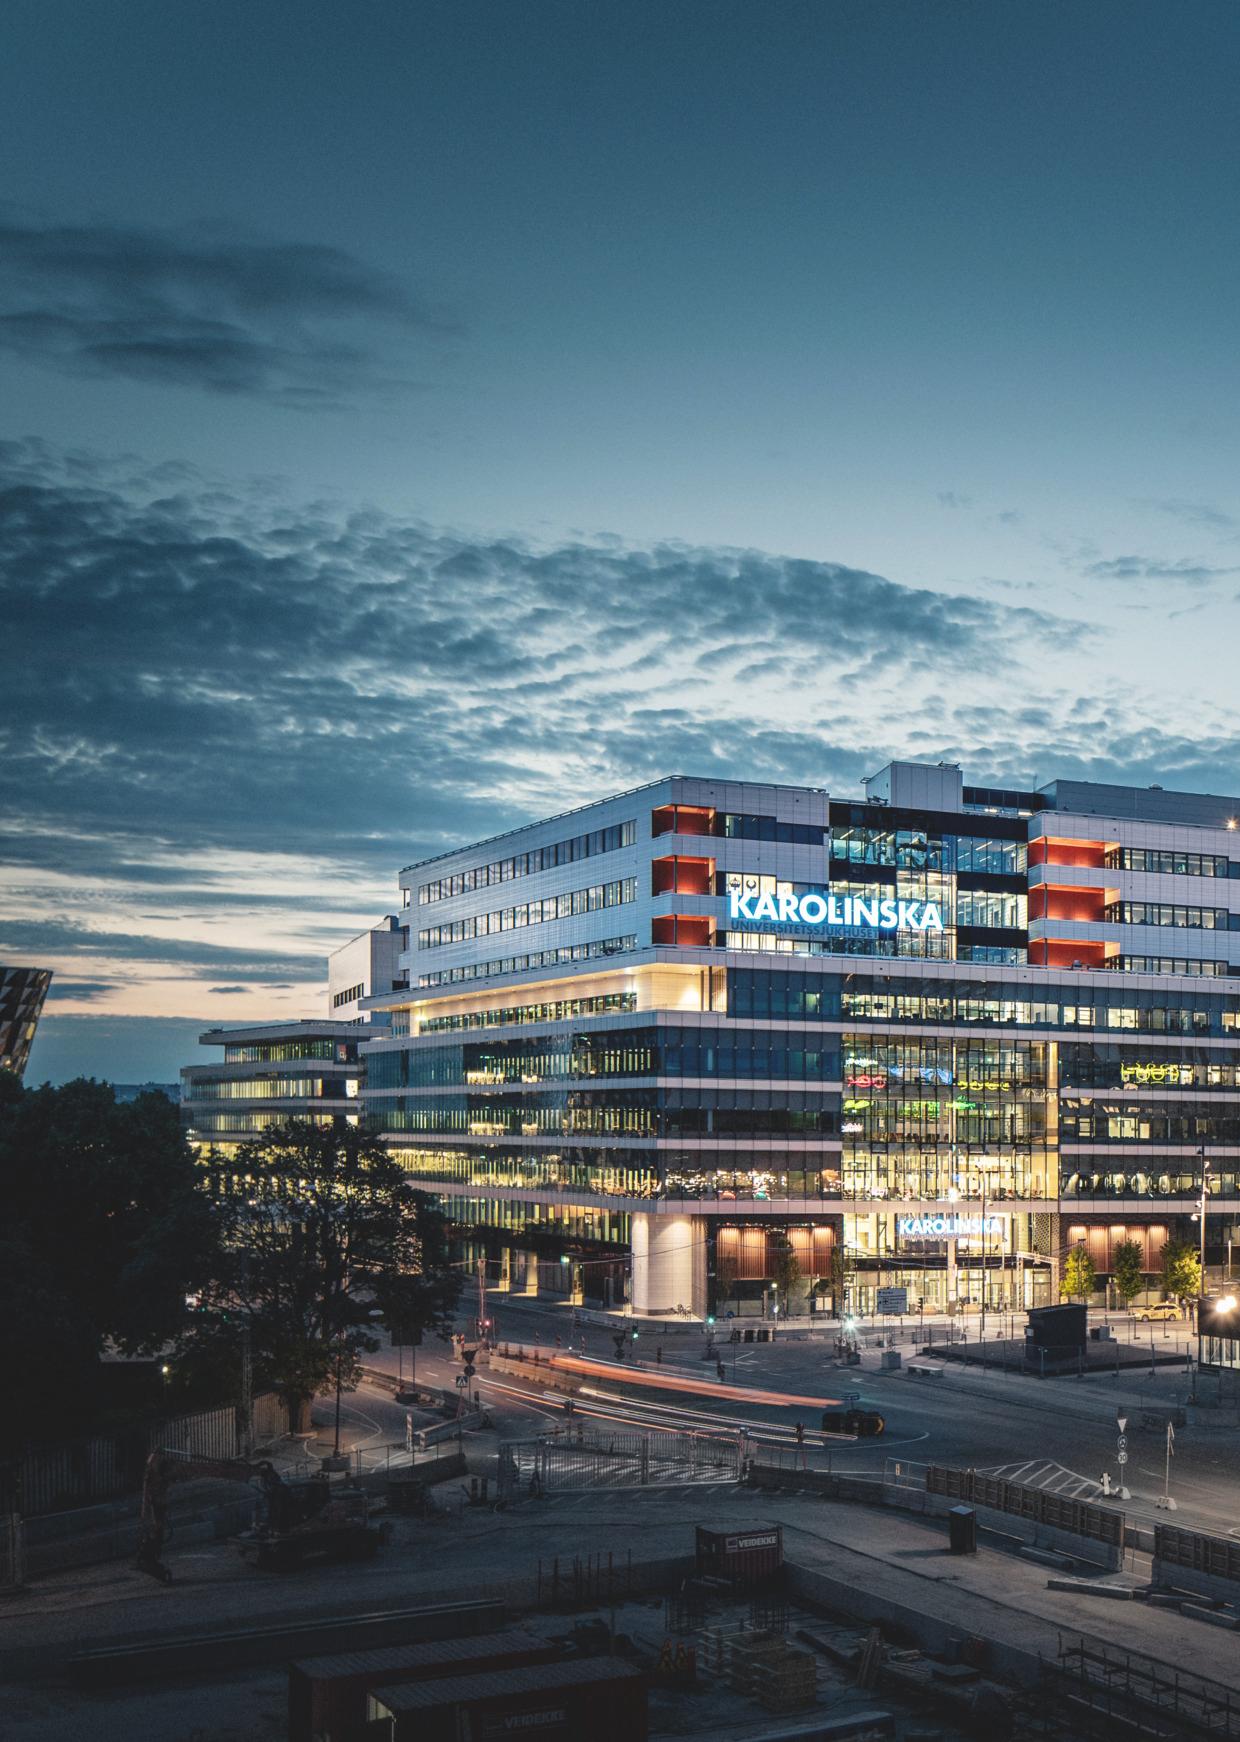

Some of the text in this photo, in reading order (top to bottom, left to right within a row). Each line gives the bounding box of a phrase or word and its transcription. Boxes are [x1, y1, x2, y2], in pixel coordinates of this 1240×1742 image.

[730, 887, 943, 931] KAROLINSKA
[731, 920, 879, 939] UNIVERSITETSSJUKHUSET
[899, 1219, 1002, 1235] KAROLINSKA
[738, 1536, 777, 1548] VEIDEKKE
